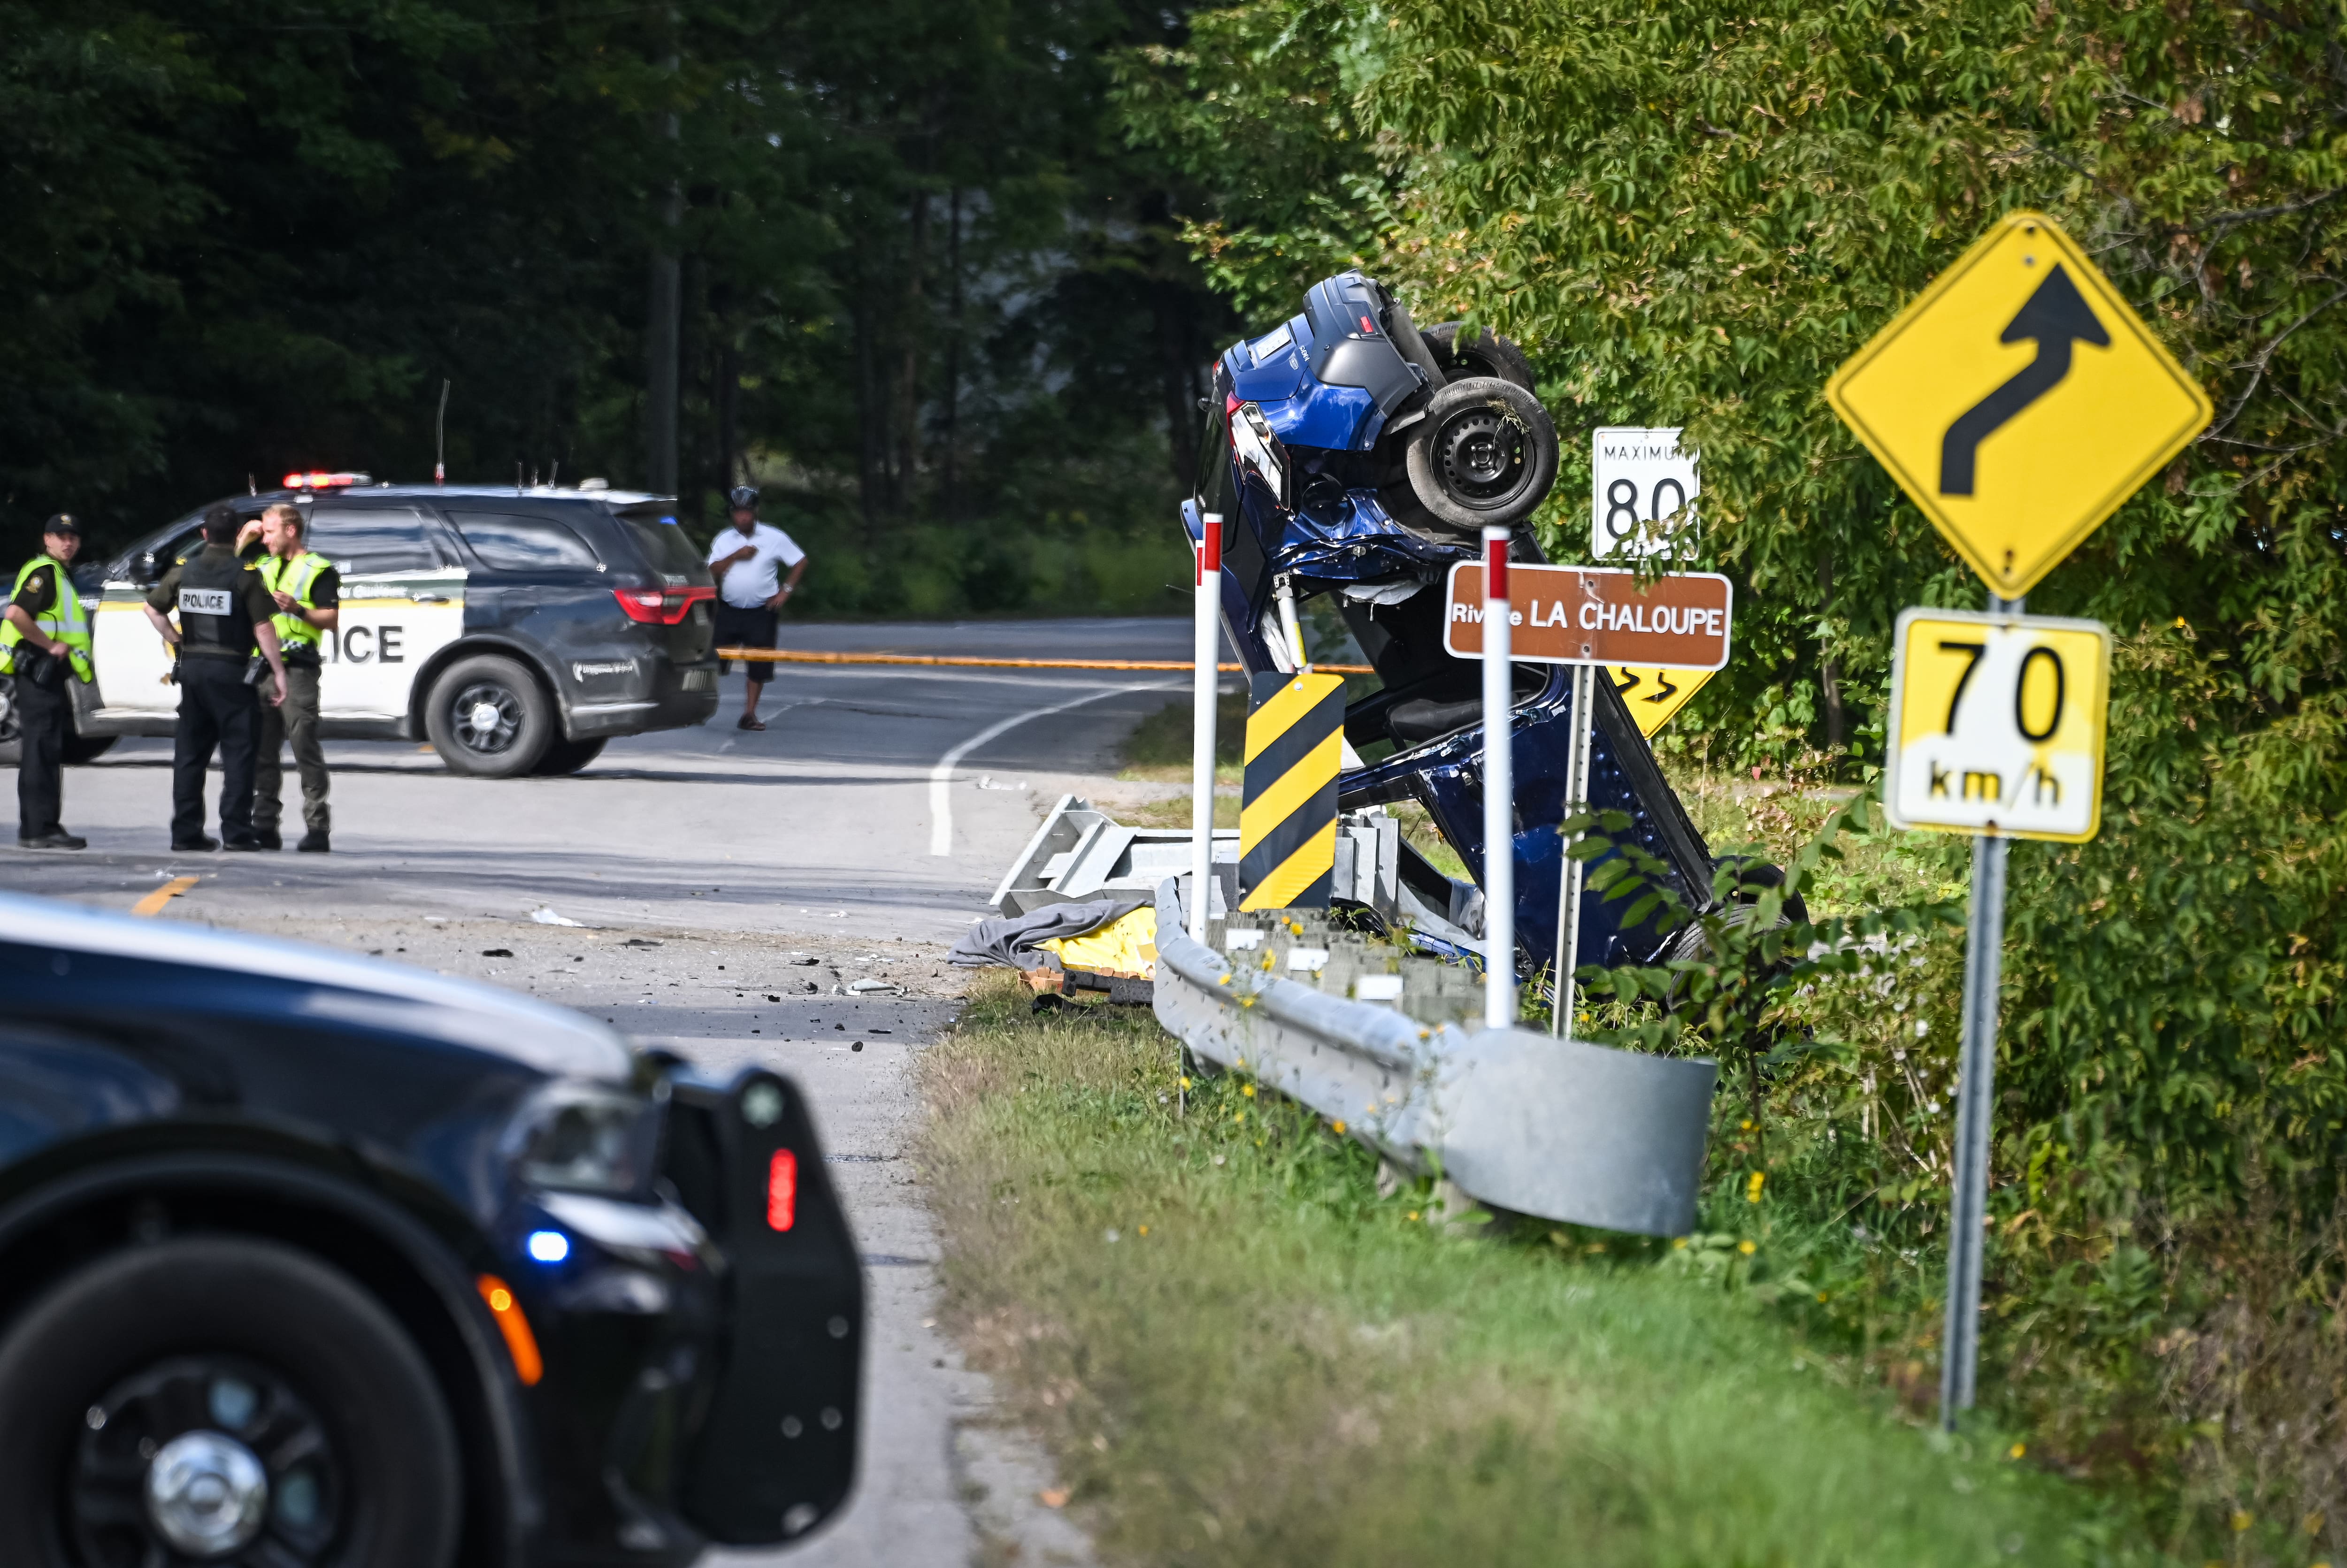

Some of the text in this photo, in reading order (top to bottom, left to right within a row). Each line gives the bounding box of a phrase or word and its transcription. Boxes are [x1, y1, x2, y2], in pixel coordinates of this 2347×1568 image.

[1606, 478, 1686, 540] 80
[183, 594, 224, 609] POLICE
[1451, 599, 1724, 636] Rive LA CHALOUPE
[321, 625, 405, 664] ICE
[1939, 641, 2065, 742] 70
[1930, 759, 2059, 811] km/h
